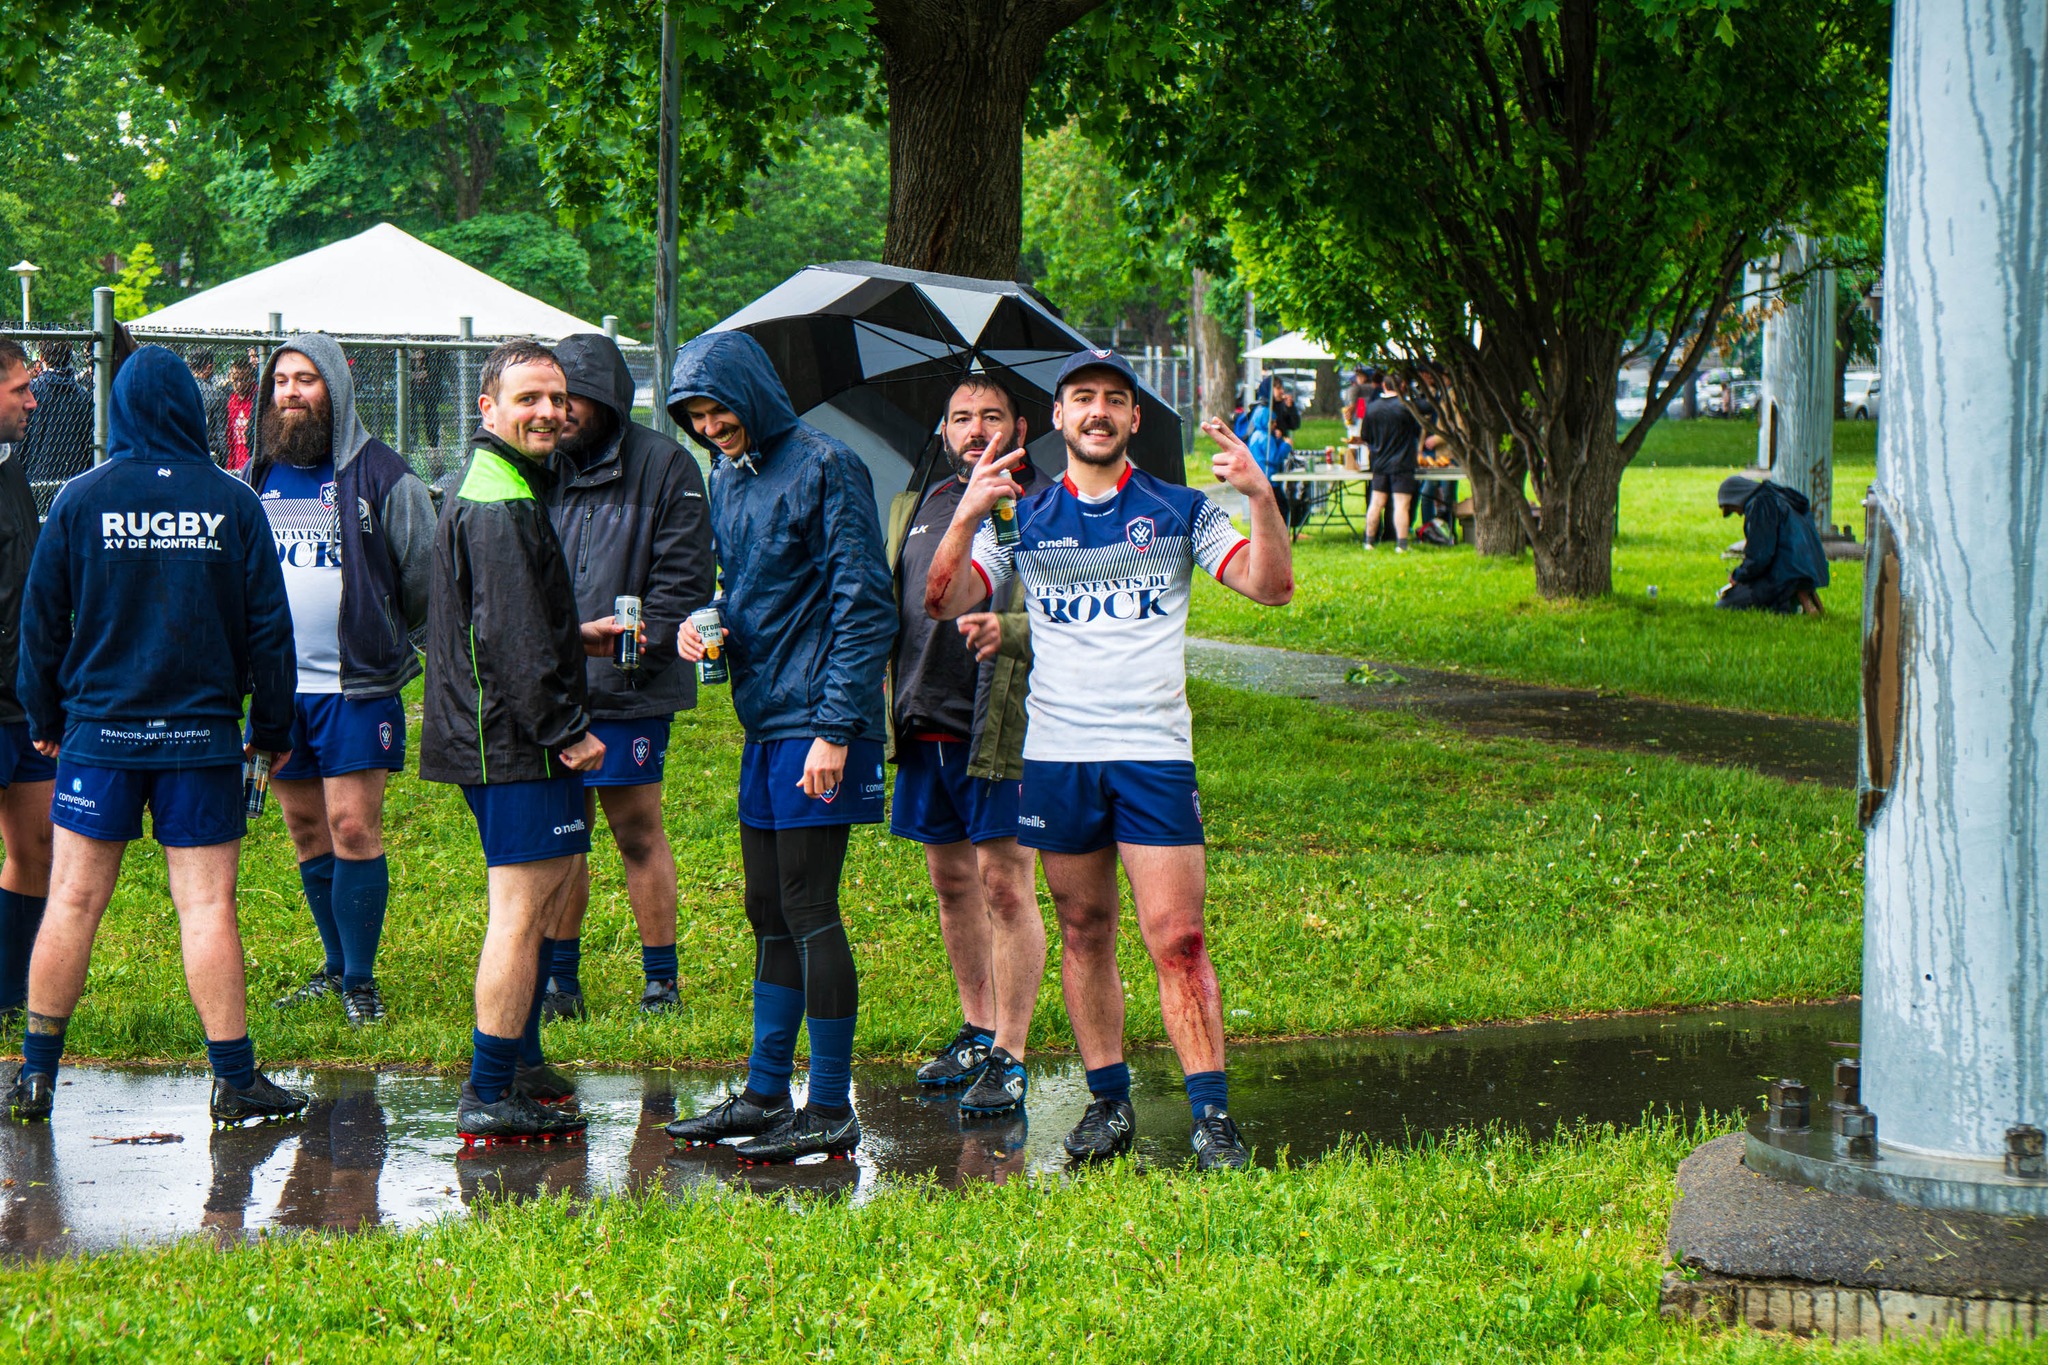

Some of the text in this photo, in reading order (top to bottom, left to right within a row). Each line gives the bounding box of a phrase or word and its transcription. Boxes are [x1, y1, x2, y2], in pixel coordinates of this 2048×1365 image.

[102, 511, 225, 537] RUGBY
[104, 538, 124, 549] XV
[128, 538, 147, 549] DE
[273, 530, 321, 541] NFANTS
[1036, 574, 1170, 597] LES ENFANTS DU
[1037, 588, 1169, 623] ROCK
[174, 729, 211, 739] DUFFAUD
[58, 792, 96, 809] conversion
